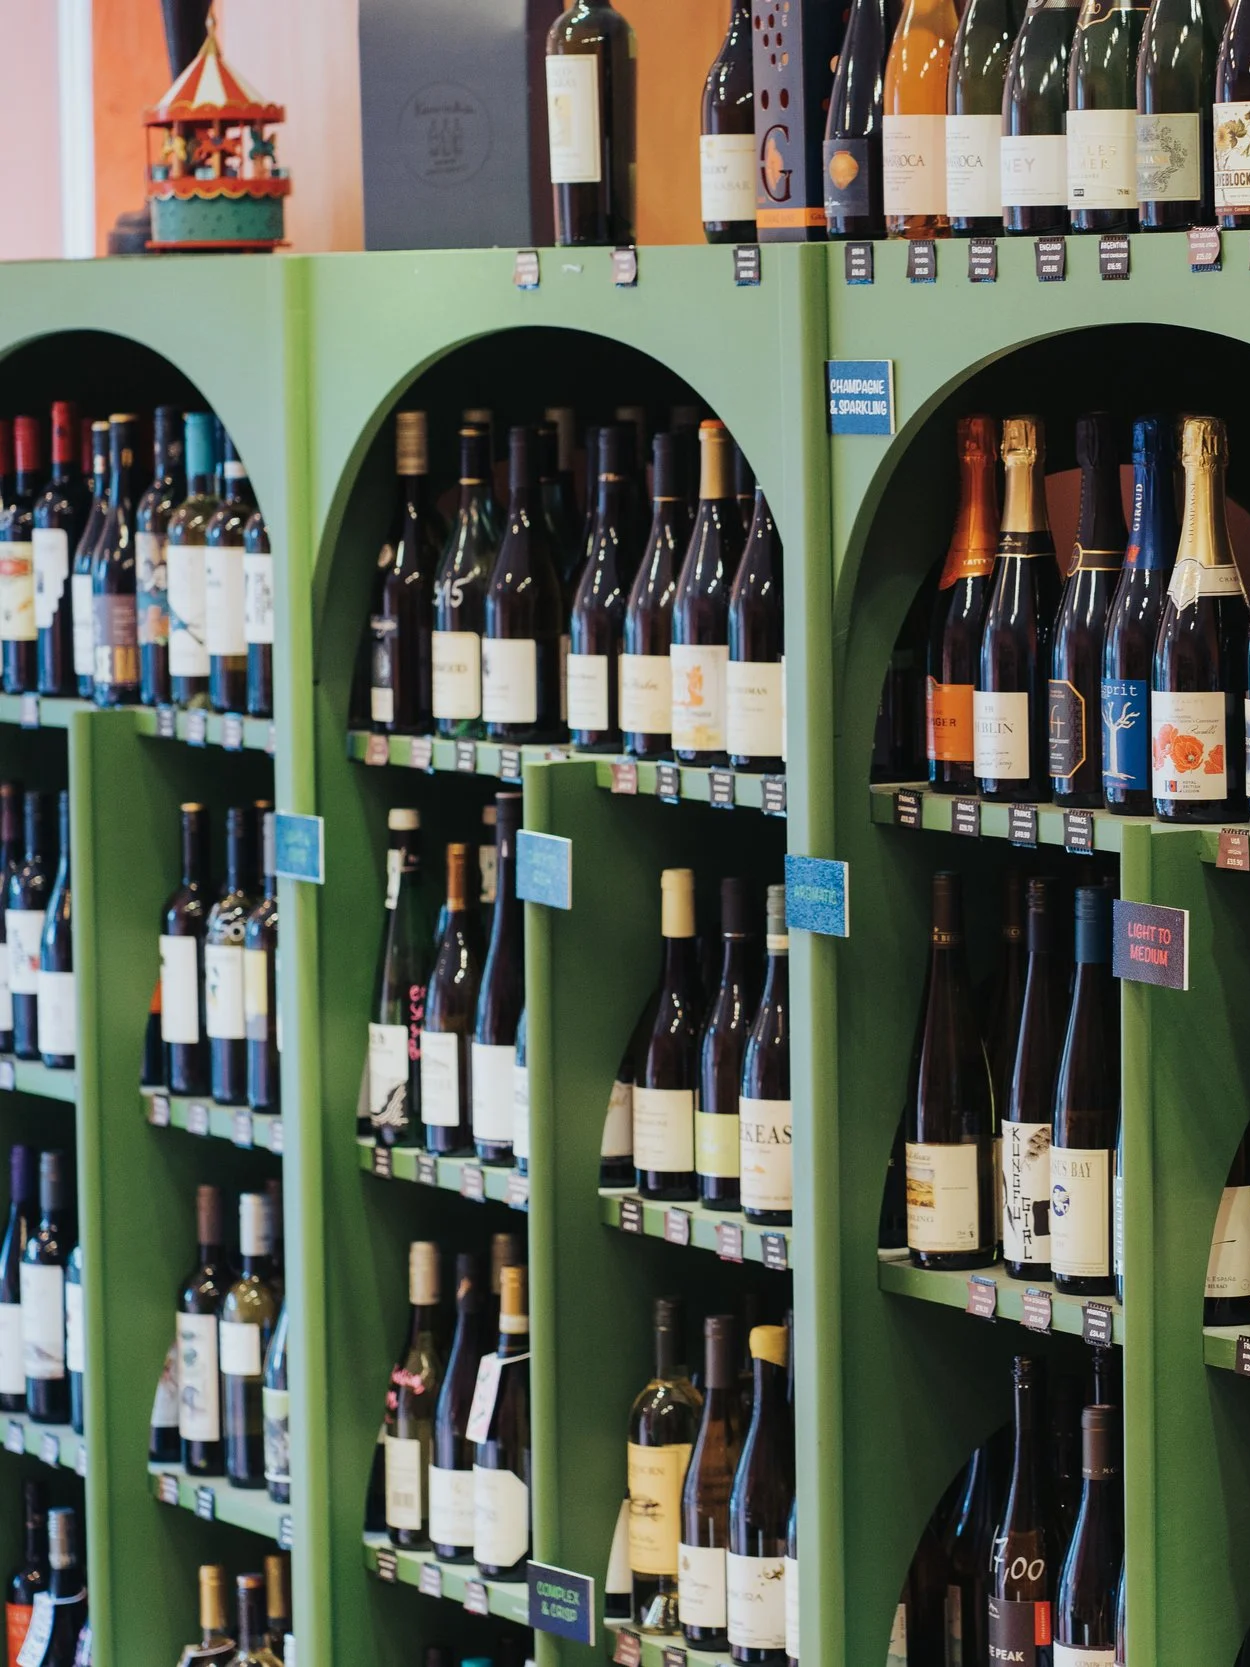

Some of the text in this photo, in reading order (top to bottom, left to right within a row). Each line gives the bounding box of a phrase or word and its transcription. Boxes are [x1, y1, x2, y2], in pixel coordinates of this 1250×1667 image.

[972, 246, 992, 254] ENGLAND
[1039, 243, 1061, 252] ENGLAND
[1101, 241, 1128, 250] ARGENTINA
[830, 378, 885, 395] CHAMPAGNE
[829, 399, 887, 416] & SPARKLING
[1132, 483, 1144, 531] GIRAUD
[957, 803, 974, 813] FRANCE
[1014, 809, 1031, 819] FRANCE
[1069, 815, 1087, 825] FRANCE
[1230, 837, 1240, 845] USA
[1127, 921, 1172, 945] LIGHT TO
[1129, 943, 1169, 968] MEDIUM
[1071, 1161, 1093, 1178] BAY
[1021, 1197, 1033, 1260] GIRL
[995, 1648, 1025, 1662] PEAK
